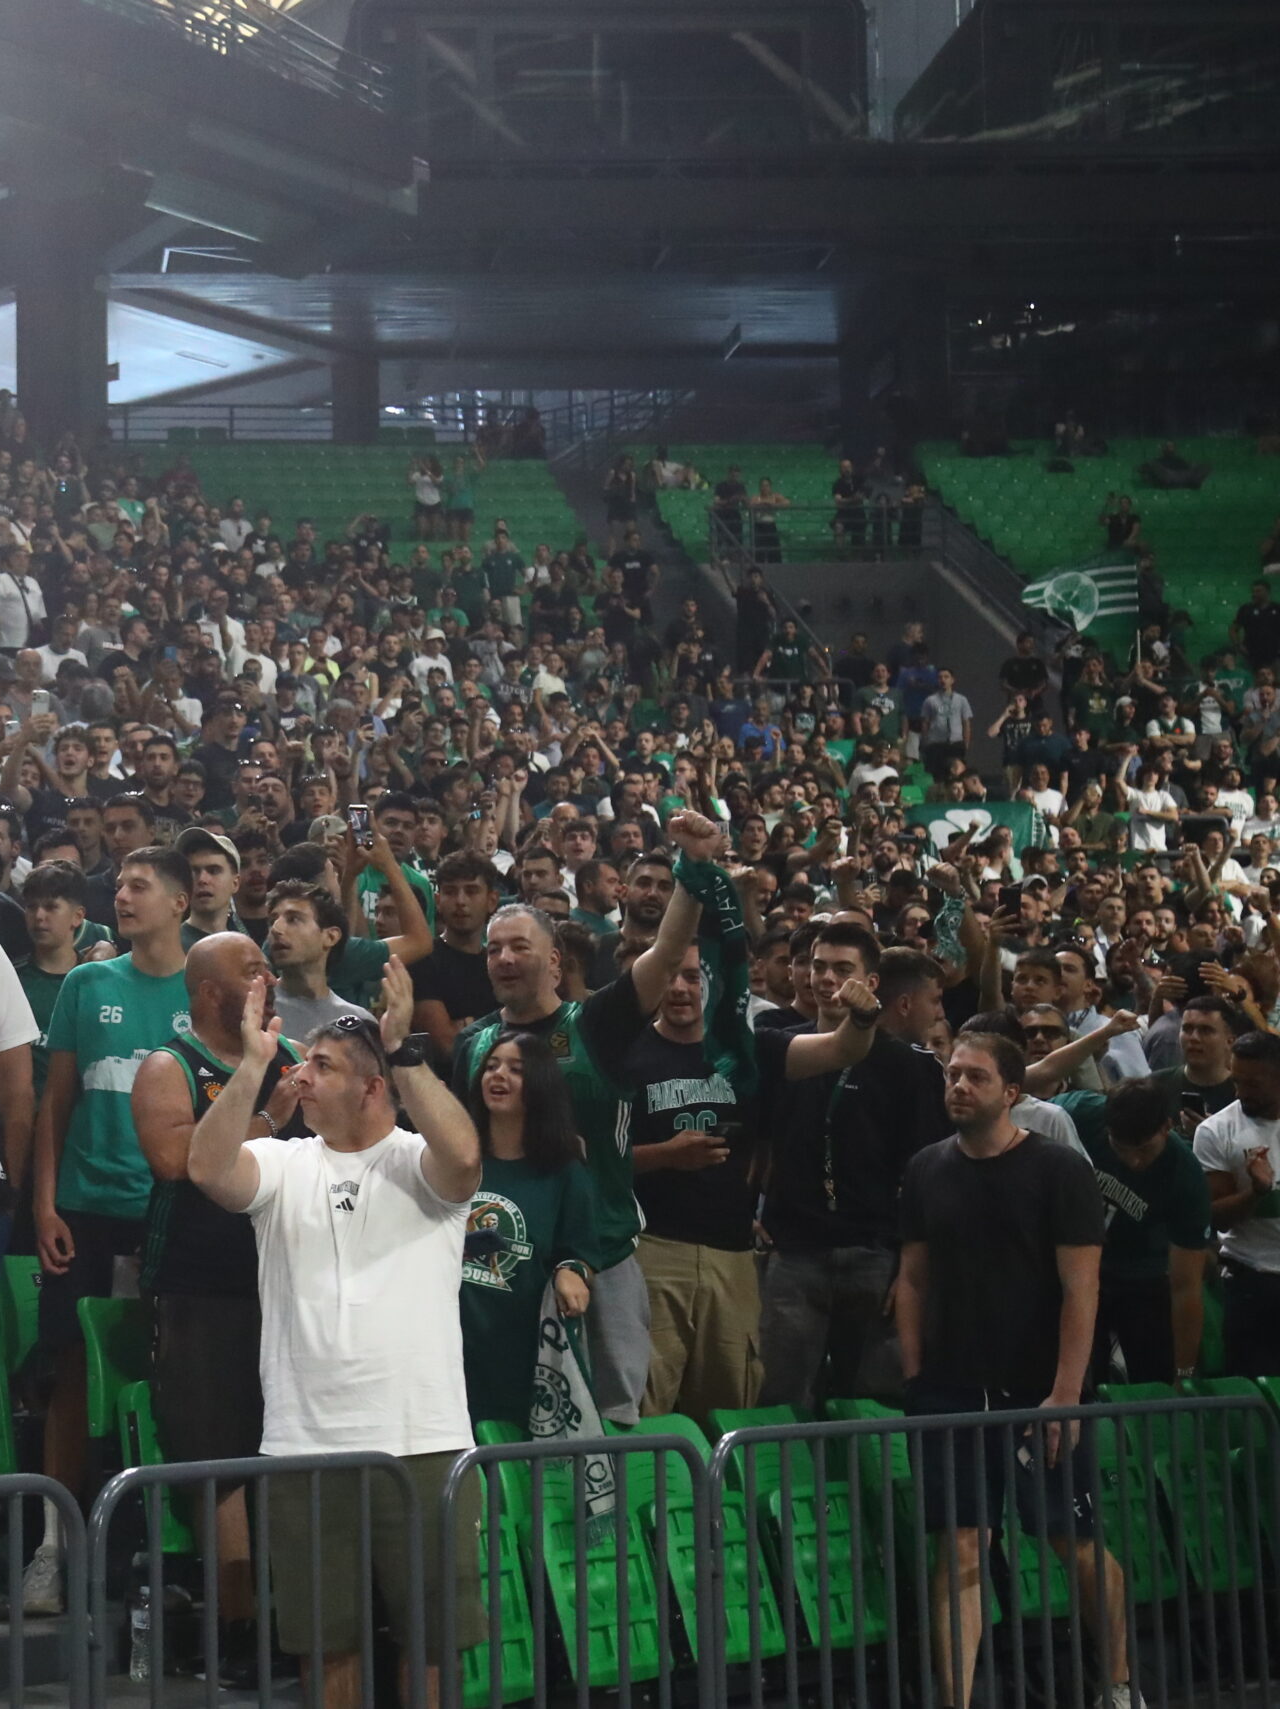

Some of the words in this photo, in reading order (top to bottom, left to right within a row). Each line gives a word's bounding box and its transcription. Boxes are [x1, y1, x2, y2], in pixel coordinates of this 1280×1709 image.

[99, 1005, 123, 1024] 26
[510, 1243, 530, 1256] OUR
[462, 1266, 498, 1284] OUSE
